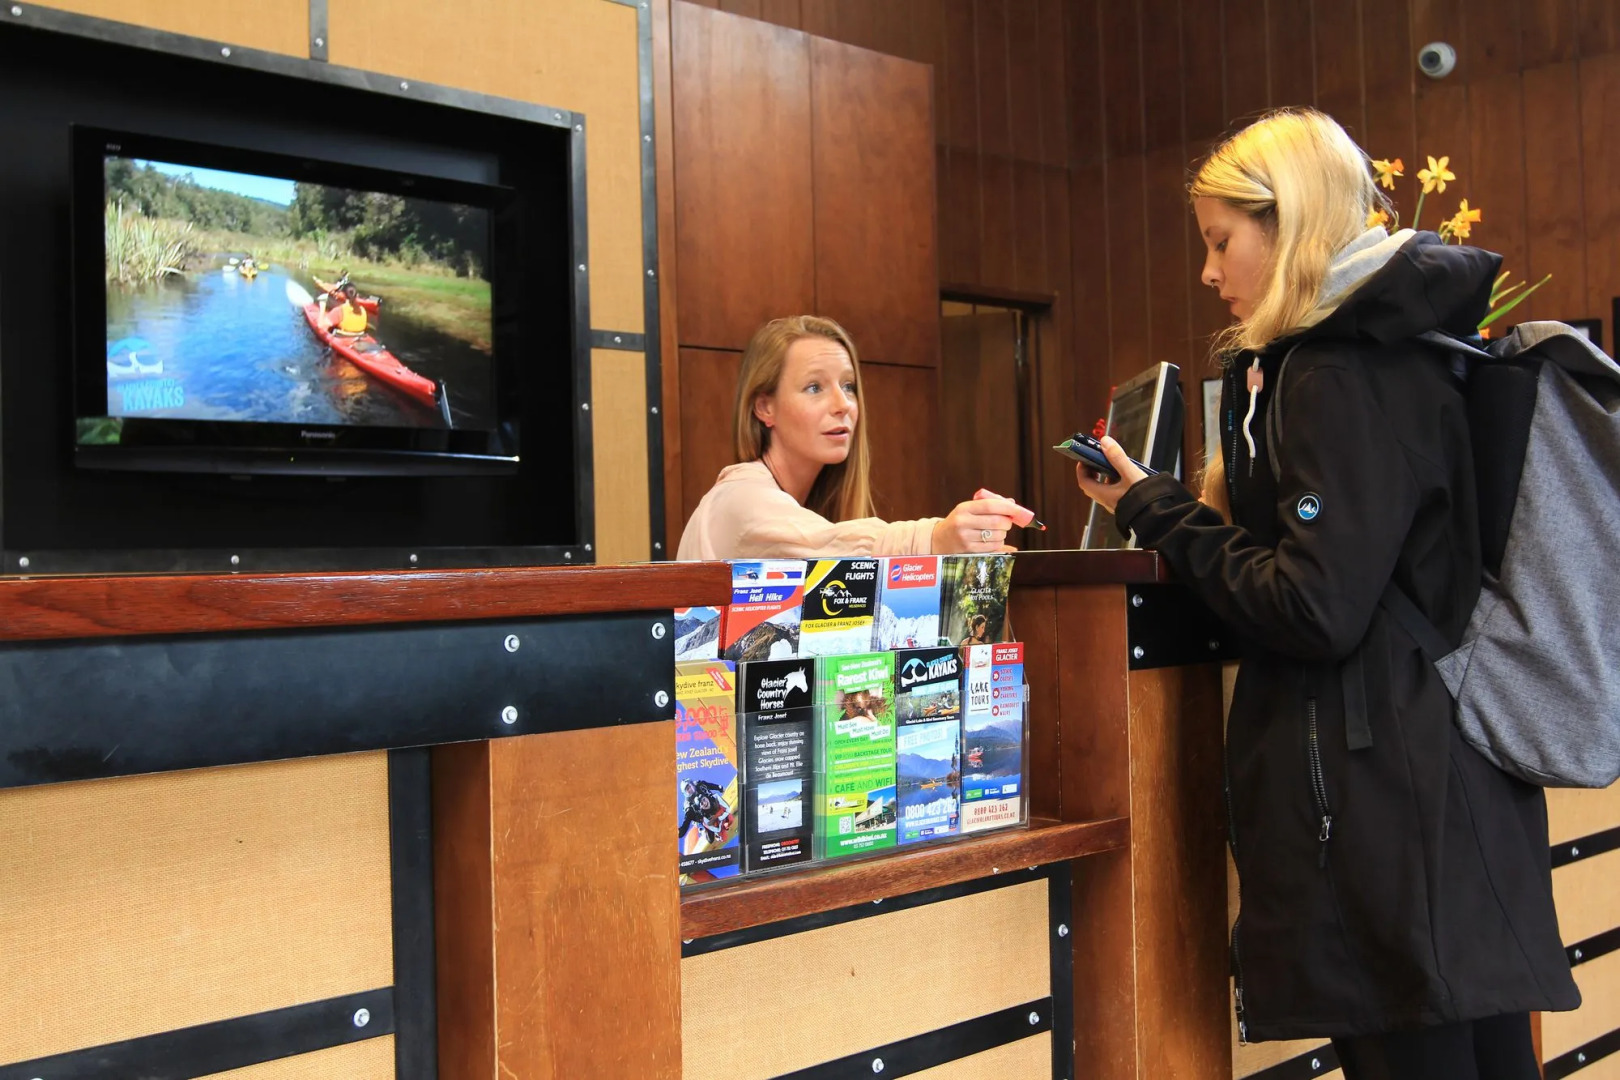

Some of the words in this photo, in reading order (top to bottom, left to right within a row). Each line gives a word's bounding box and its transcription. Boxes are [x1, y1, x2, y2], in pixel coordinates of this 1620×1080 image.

[123, 386, 185, 411] KAYAKS
[301, 430, 335, 439] Panasonic
[851, 562, 876, 570] SCENIC
[902, 564, 924, 572] Glacier
[845, 572, 874, 581] FLIGHTS
[902, 572, 935, 582] Helicopters
[749, 593, 764, 602] Heli
[766, 592, 783, 602] Hike
[850, 596, 868, 604] FRANZ
[996, 654, 1018, 662] GLACIER
[868, 665, 888, 680] Kiwi
[928, 659, 958, 680] KAYAKS
[676, 682, 696, 690] kydive
[760, 677, 787, 689] Glacier
[971, 682, 989, 694] LAKE
[757, 689, 787, 700] Country
[760, 700, 784, 710] Horses
[971, 695, 989, 705] TOURS
[676, 751, 688, 760] ew
[854, 749, 880, 757] BACKSTAGE
[677, 761, 698, 772] ghest
[700, 757, 729, 768] Skydive
[835, 783, 855, 793] CAFE
[857, 780, 874, 789] AND
[875, 777, 892, 787] WIFI
[905, 804, 924, 820] 0800
[926, 802, 940, 815] 423
[942, 799, 956, 814] 262
[974, 806, 987, 816] 0800
[988, 805, 998, 814] 423
[999, 803, 1008, 812] 262
